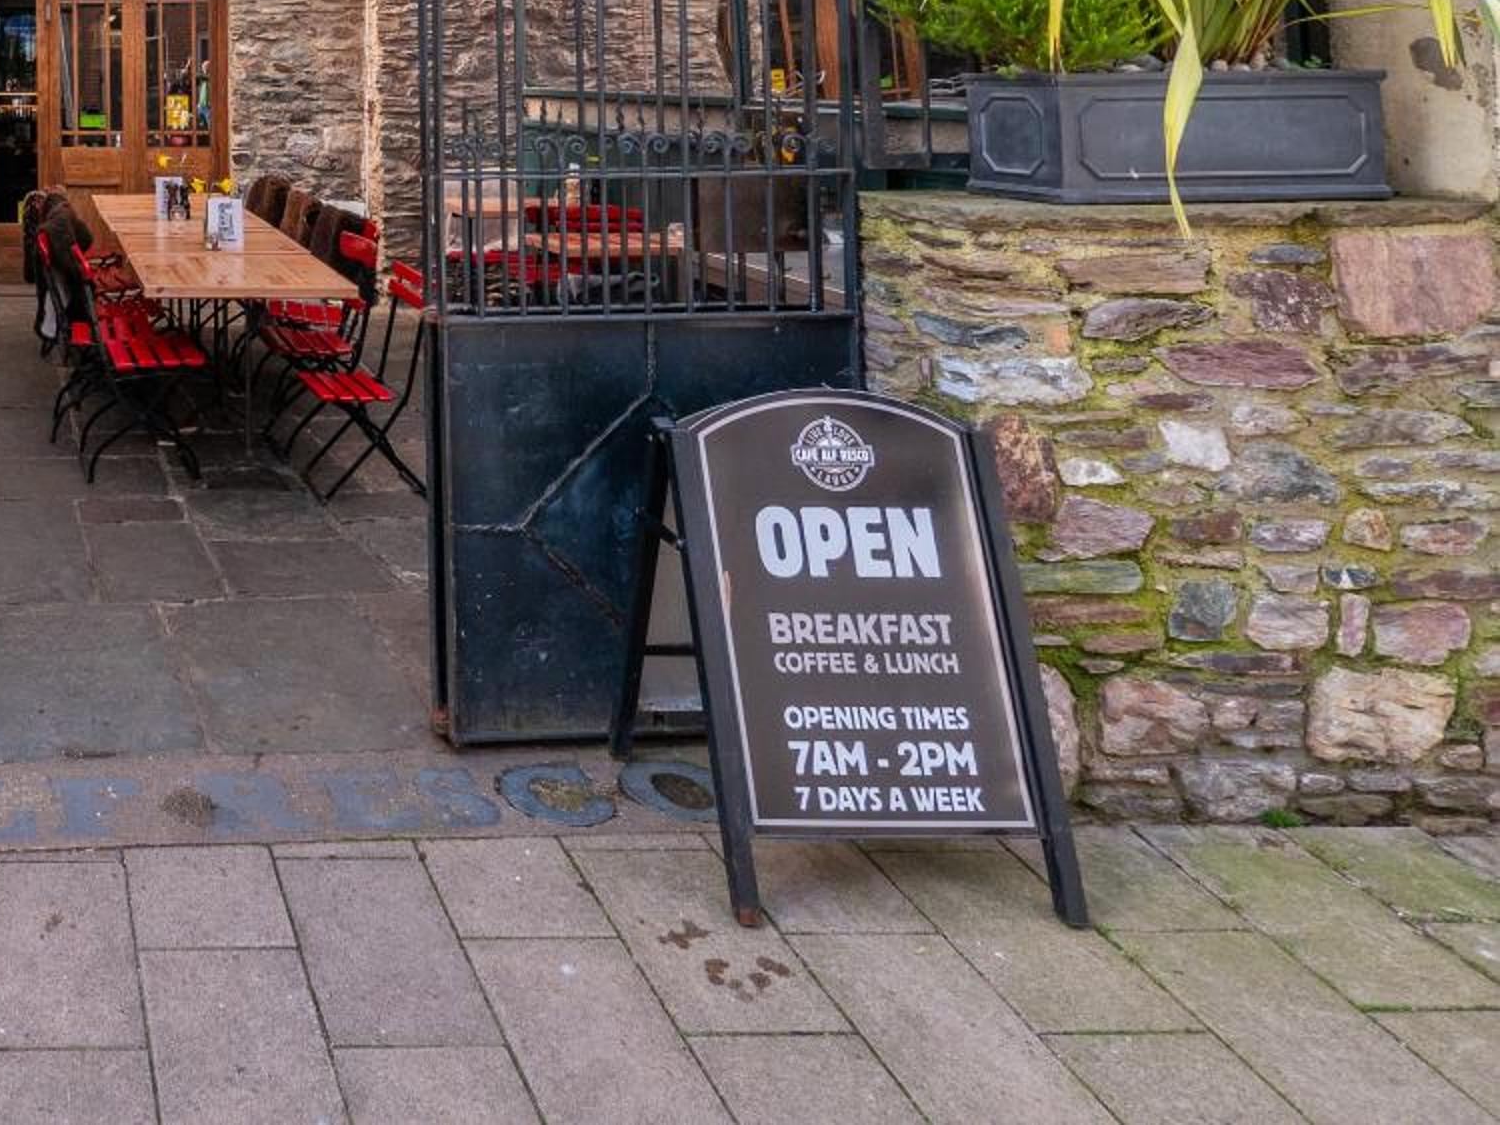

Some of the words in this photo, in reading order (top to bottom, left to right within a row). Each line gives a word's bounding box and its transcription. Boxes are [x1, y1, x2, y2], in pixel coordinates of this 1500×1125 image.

[755, 506, 941, 578] OPEN
[768, 613, 952, 645] BREAKFAST
[773, 652, 858, 674] COFFEE
[863, 652, 880, 674] &
[883, 652, 961, 674] LUNCH
[783, 706, 897, 731] OPENING
[900, 706, 970, 731] TIMES
[787, 740, 869, 776] 7AM
[876, 758, 890, 768] -
[897, 741, 979, 776] 2PM
[794, 787, 811, 811] 7
[817, 786, 883, 812] DAYS
[889, 786, 908, 812] A
[910, 786, 986, 812] WEEK
